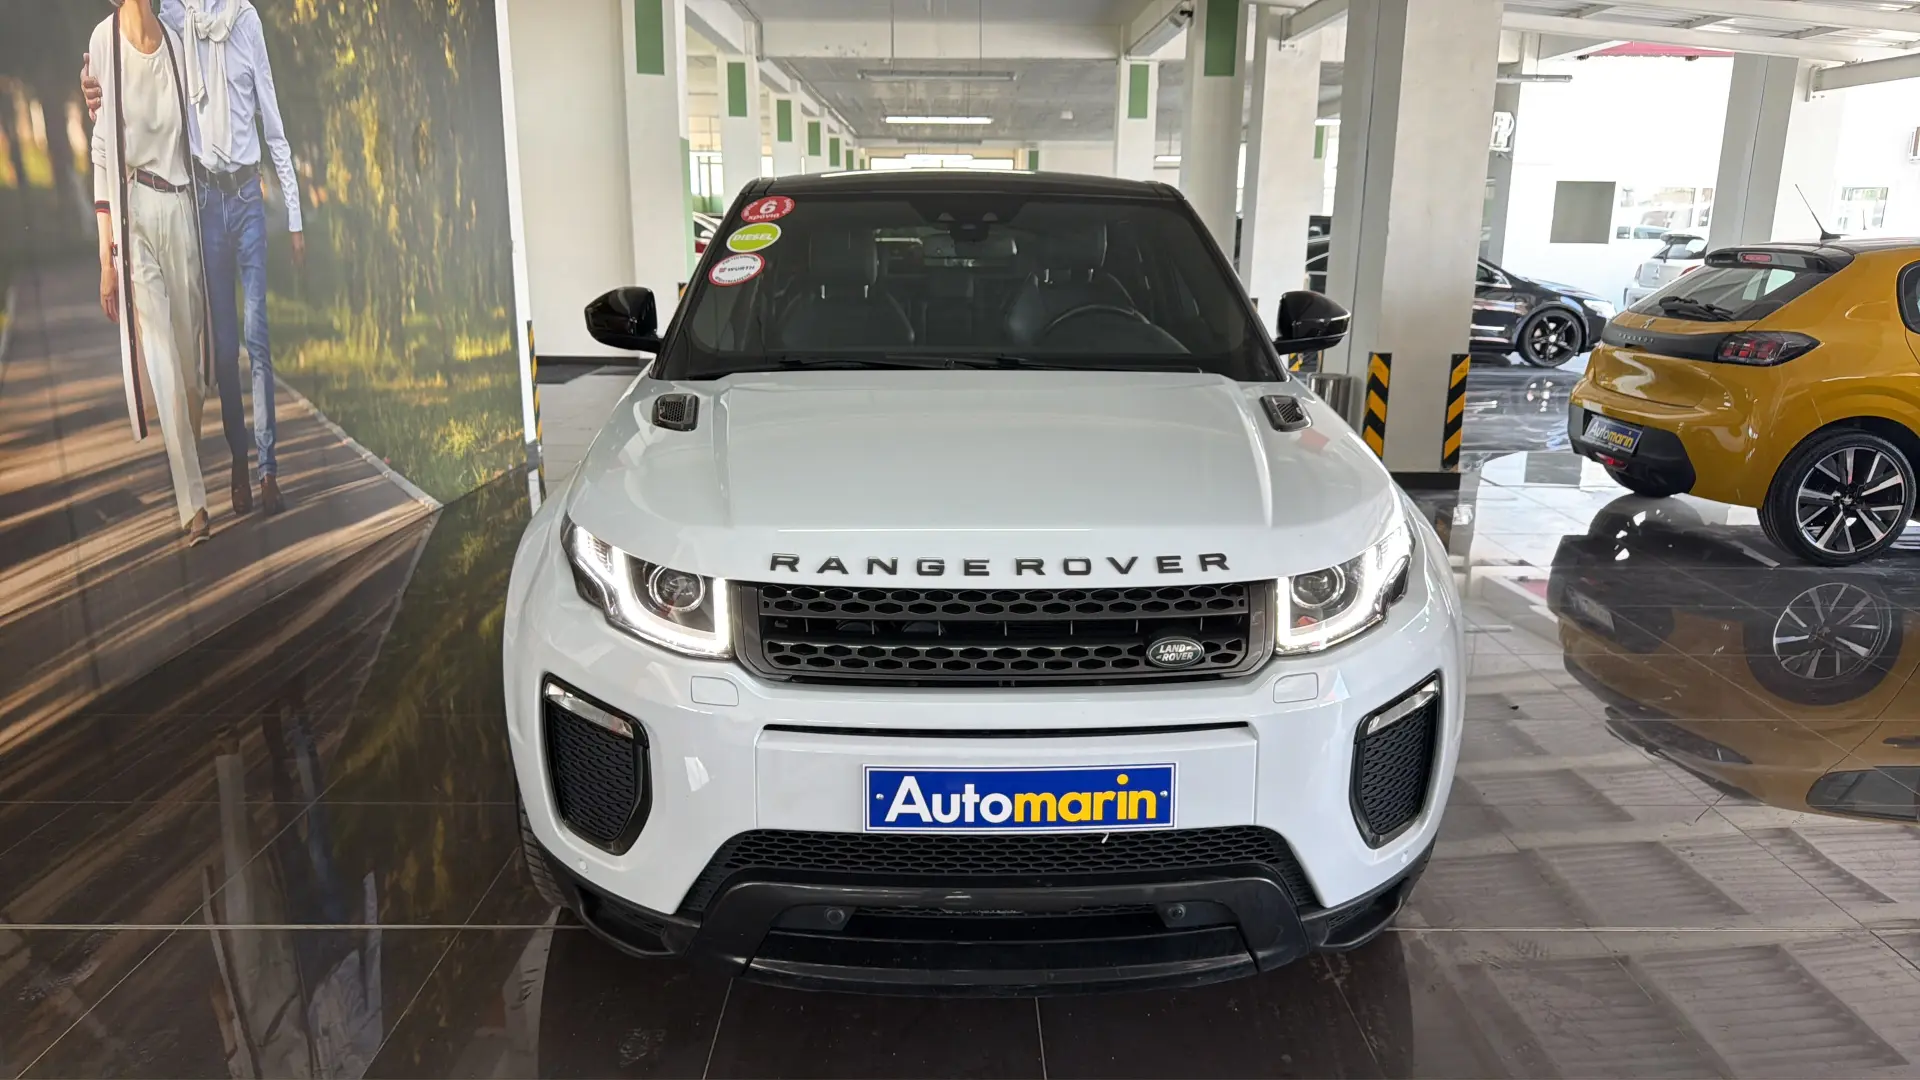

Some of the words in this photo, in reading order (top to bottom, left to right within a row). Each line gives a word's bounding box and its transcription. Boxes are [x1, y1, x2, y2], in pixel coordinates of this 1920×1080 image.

[759, 200, 778, 214] 6
[732, 233, 772, 241] DIESEL
[1589, 420, 1634, 448] Automarin
[770, 553, 990, 577] RANGE
[1014, 553, 1230, 577] ROVER
[1159, 644, 1186, 654] LAND
[1162, 652, 1194, 662] ROVER
[884, 773, 1157, 823] Automarin
